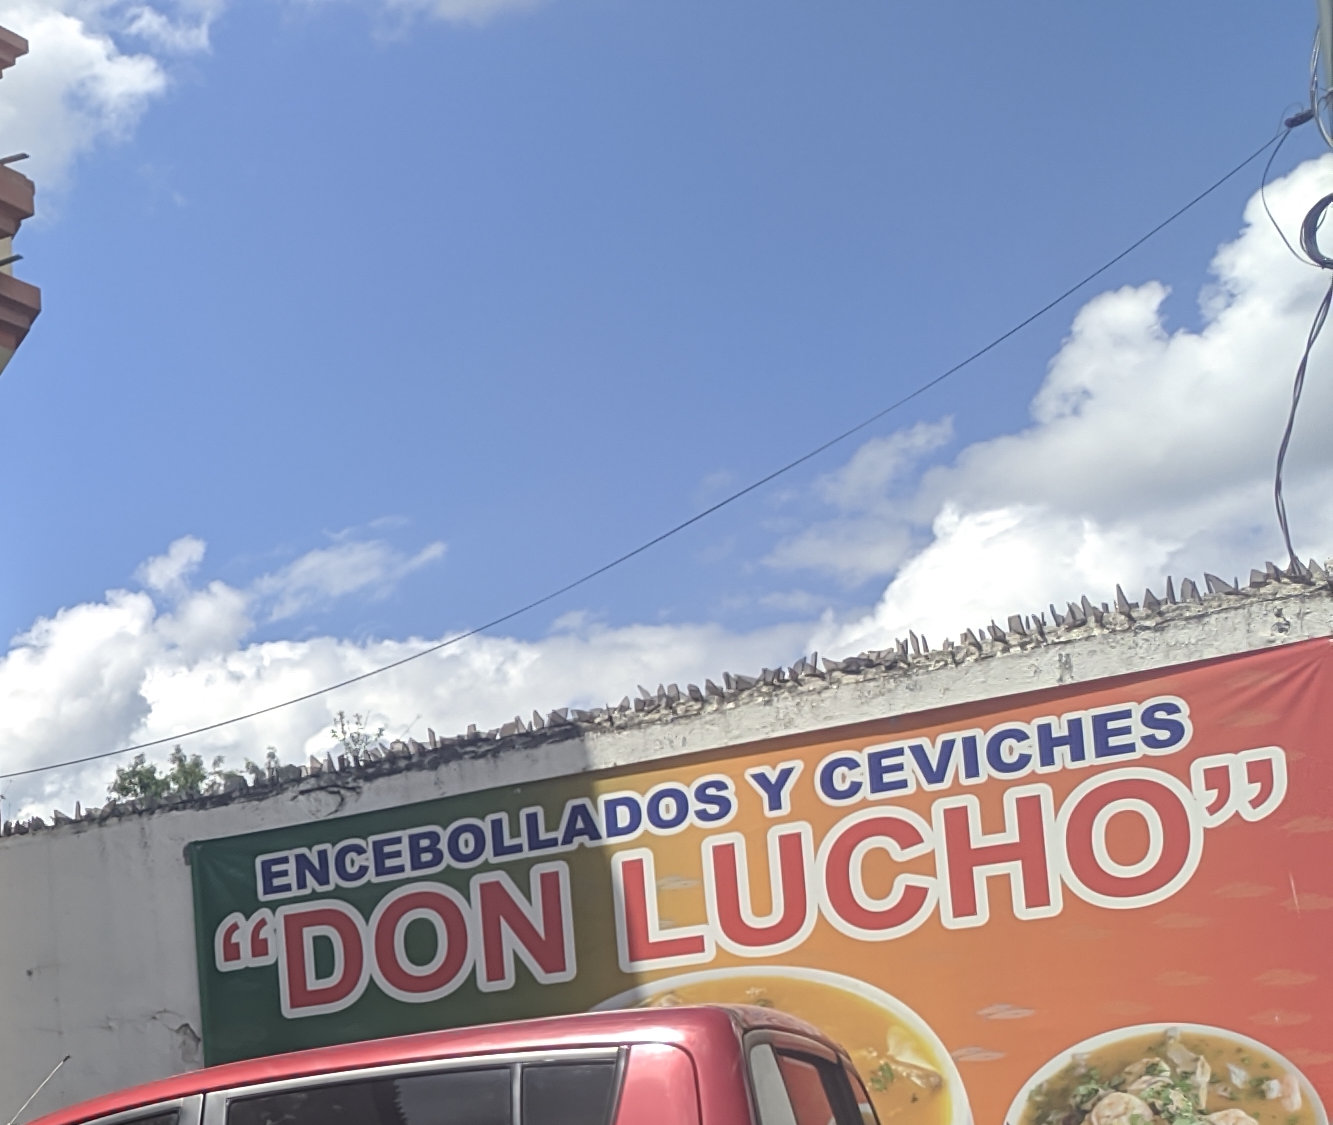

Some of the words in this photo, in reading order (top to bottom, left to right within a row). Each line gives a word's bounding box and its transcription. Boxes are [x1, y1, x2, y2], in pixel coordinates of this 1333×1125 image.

[259, 780, 733, 894] ENCEBOLLADOS
[747, 763, 801, 812] Y
[818, 697, 1190, 802] CEVICHES
